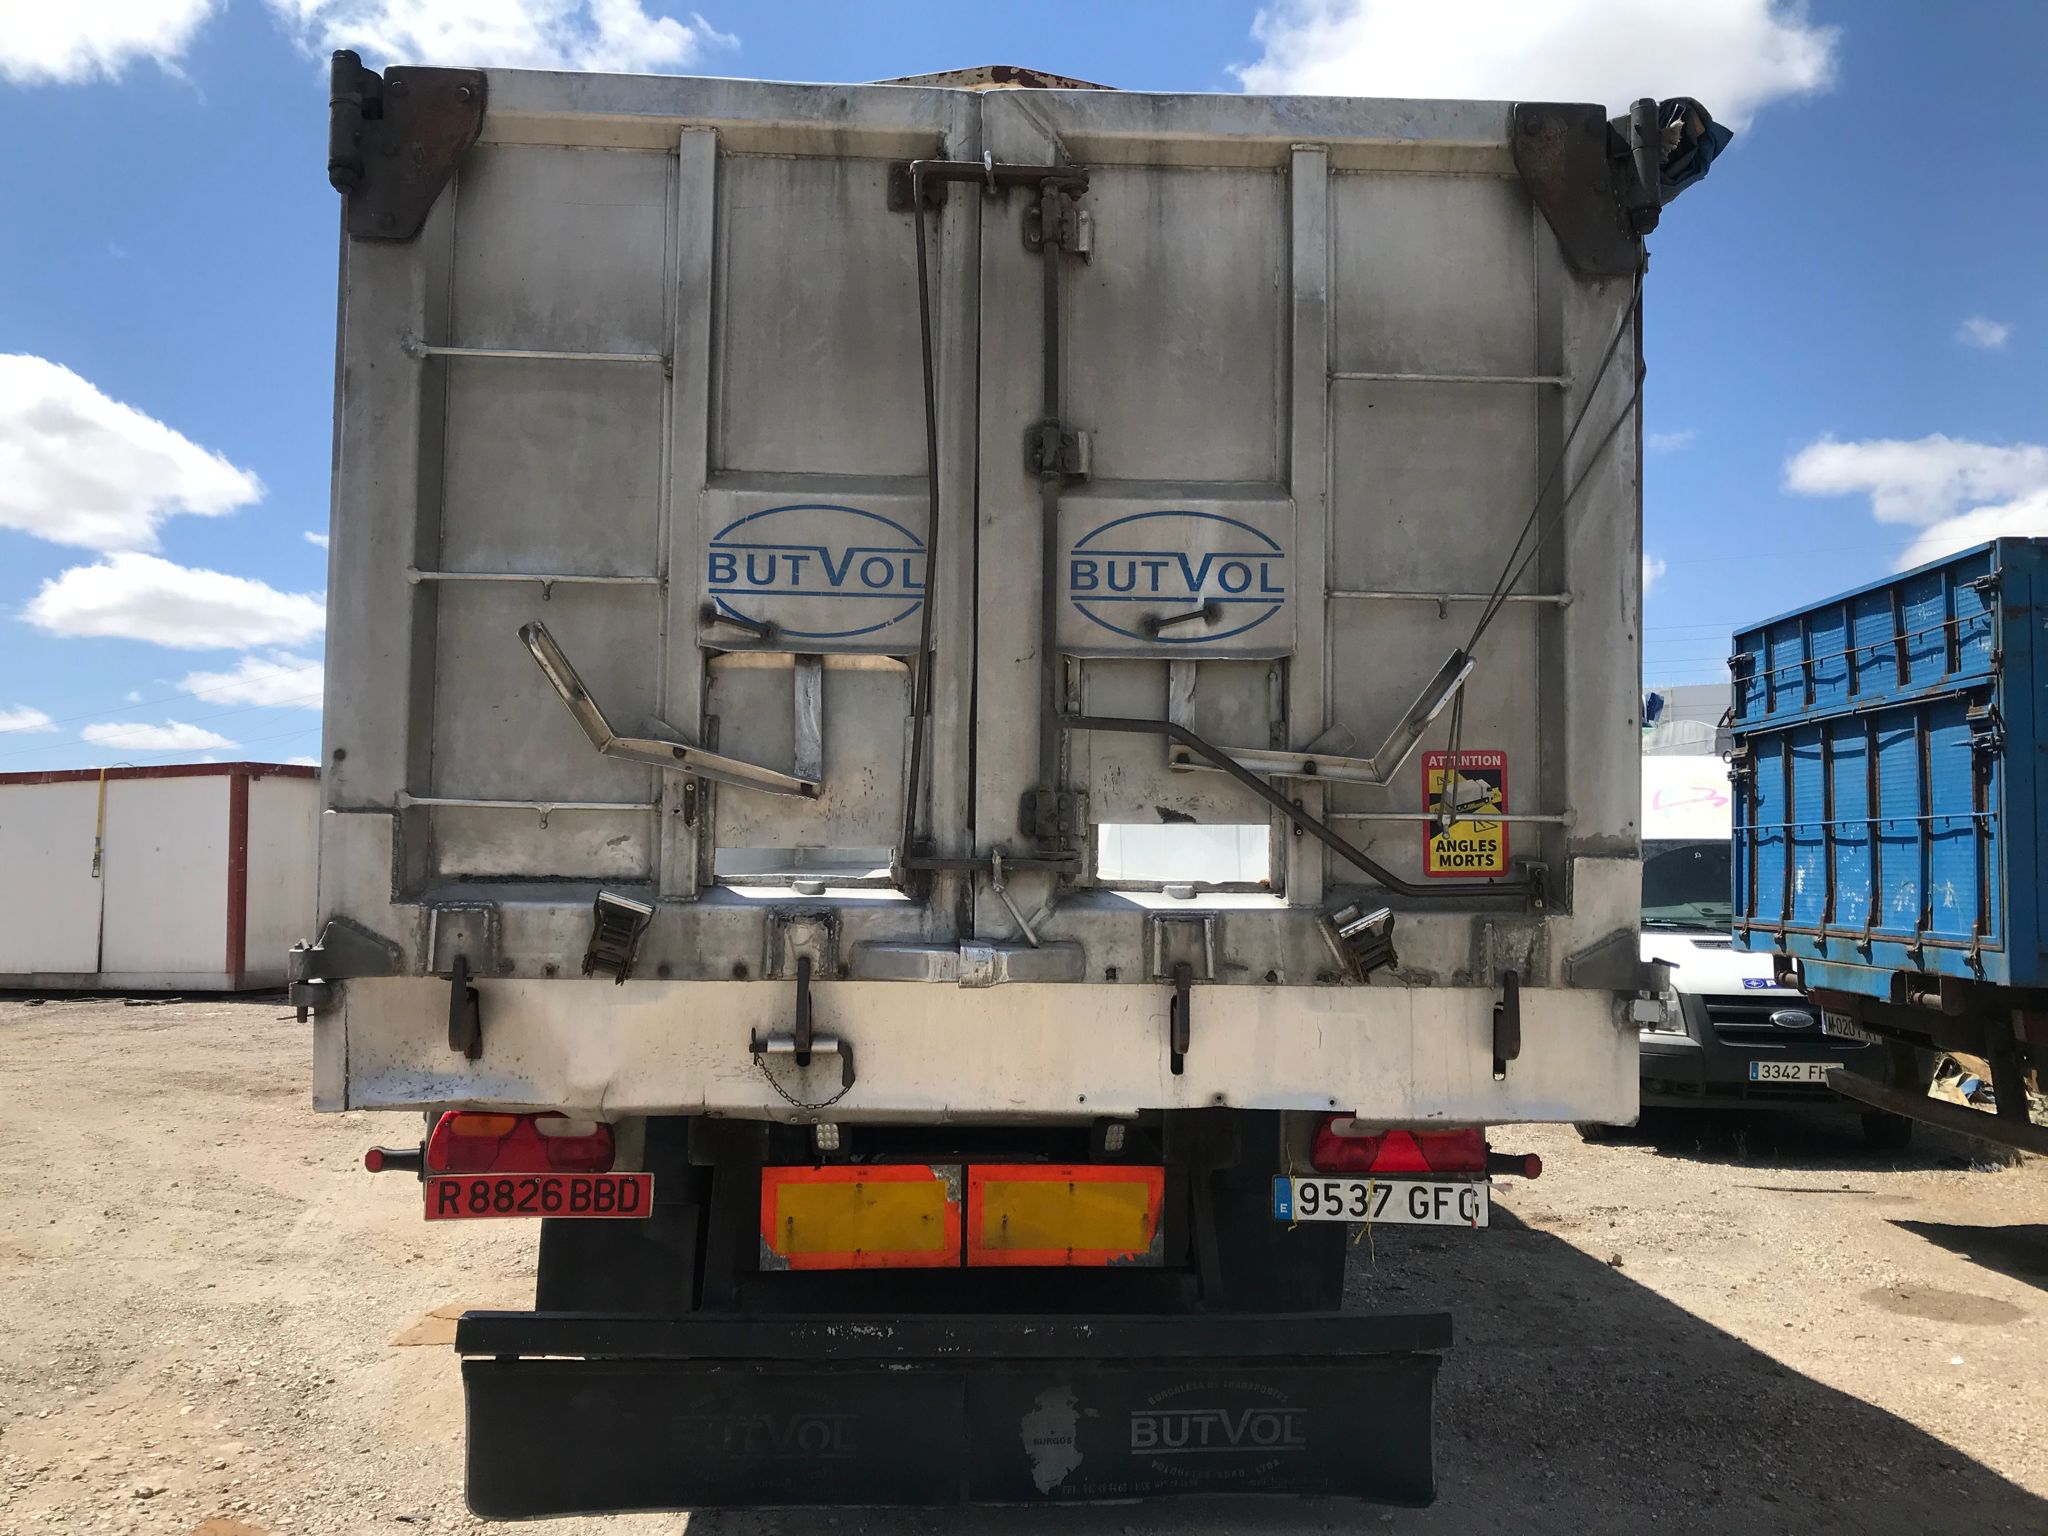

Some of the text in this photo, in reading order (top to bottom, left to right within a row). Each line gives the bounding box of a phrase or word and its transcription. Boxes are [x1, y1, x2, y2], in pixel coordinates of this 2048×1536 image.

[708, 547, 926, 589] BUTVOL
[1070, 553, 1285, 594] BUTVOL
[1435, 839, 1497, 852] ANGLES
[1439, 854, 1495, 867] MORTS
[1761, 1064, 1801, 1080] 3342
[1280, 1203, 1288, 1214] E
[1299, 1182, 1393, 1219] 9537
[1131, 1408, 1307, 1448] BUTVOL
